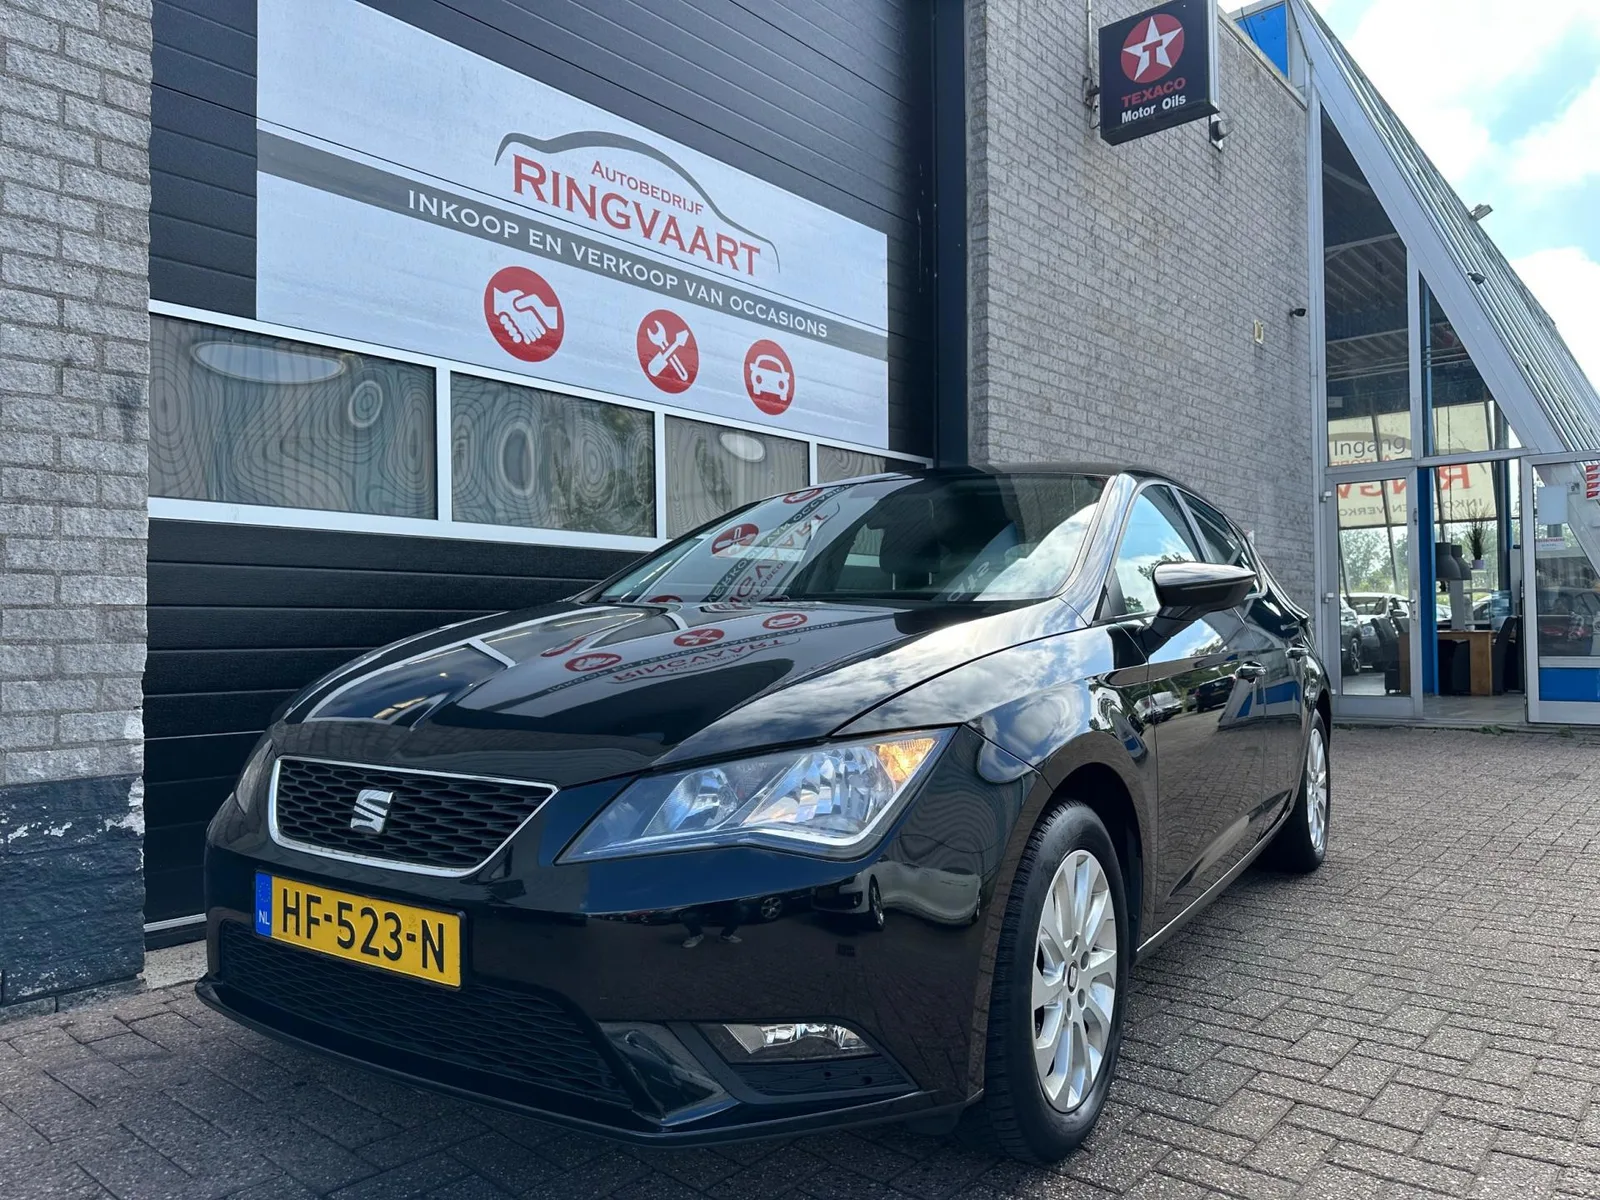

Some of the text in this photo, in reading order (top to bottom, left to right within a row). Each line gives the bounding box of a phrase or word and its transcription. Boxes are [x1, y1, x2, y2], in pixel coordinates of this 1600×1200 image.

[1121, 77, 1186, 107] TEXACO
[1121, 94, 1187, 124] Motor Oils
[591, 160, 704, 216] AUTOBEDRIJF
[512, 153, 761, 277] RINGVAART
[408, 189, 828, 338] INKOOP EN VERKOOP VAN OCCASIONS
[1333, 437, 1406, 459] Ingang
[258, 909, 271, 926] NL
[282, 887, 445, 974] HF-523-N
